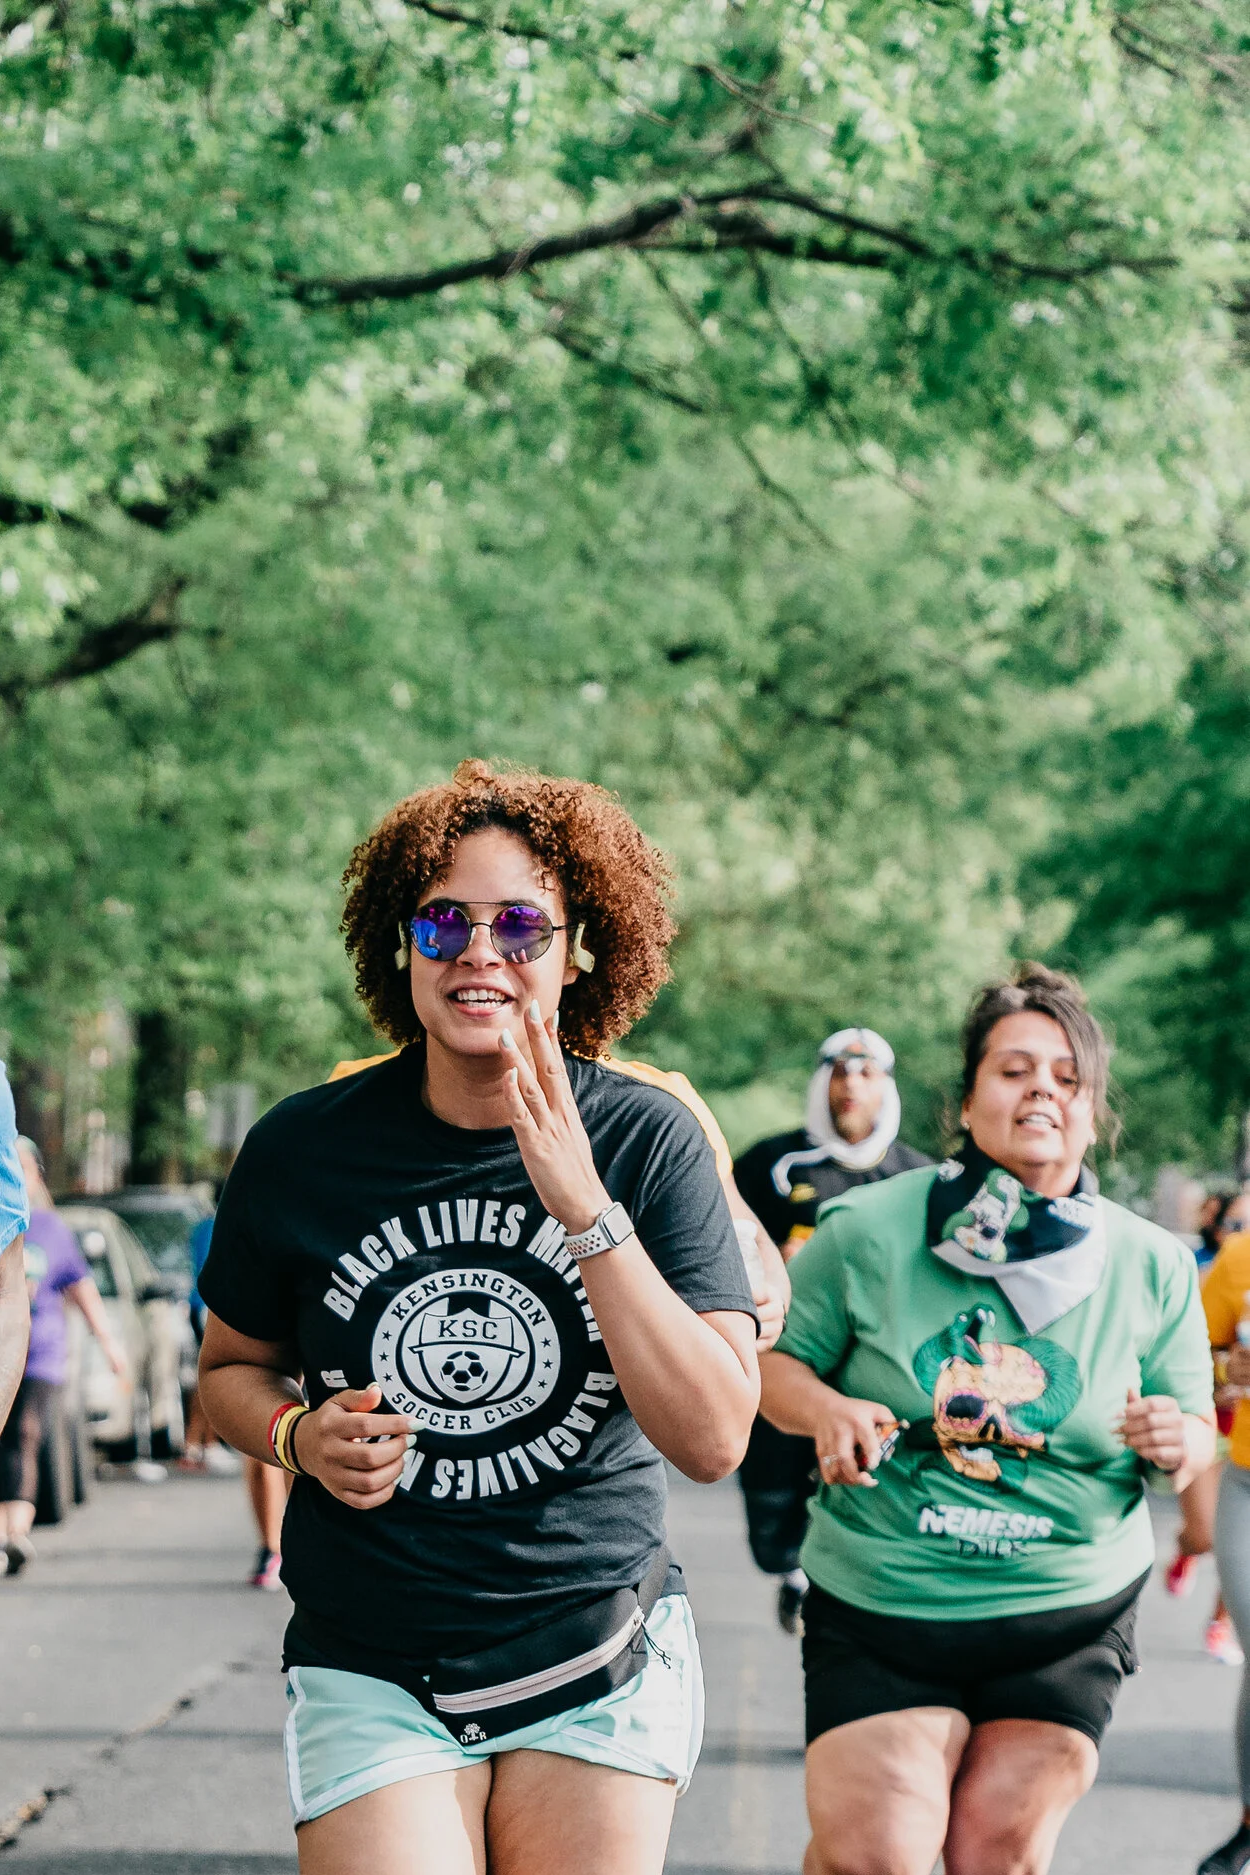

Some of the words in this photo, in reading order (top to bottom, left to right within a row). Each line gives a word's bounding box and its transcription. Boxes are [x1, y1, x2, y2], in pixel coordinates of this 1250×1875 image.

[323, 1216, 418, 1322] BLACK
[417, 1198, 527, 1249] LIVES
[391, 1273, 547, 1328] KENSINGTON
[438, 1319, 498, 1340] KSC
[391, 1391, 472, 1430] SOCCER
[483, 1395, 537, 1425] CLUB
[430, 1443, 540, 1501] LIVES
[918, 1504, 1055, 1539] NEMESIS
